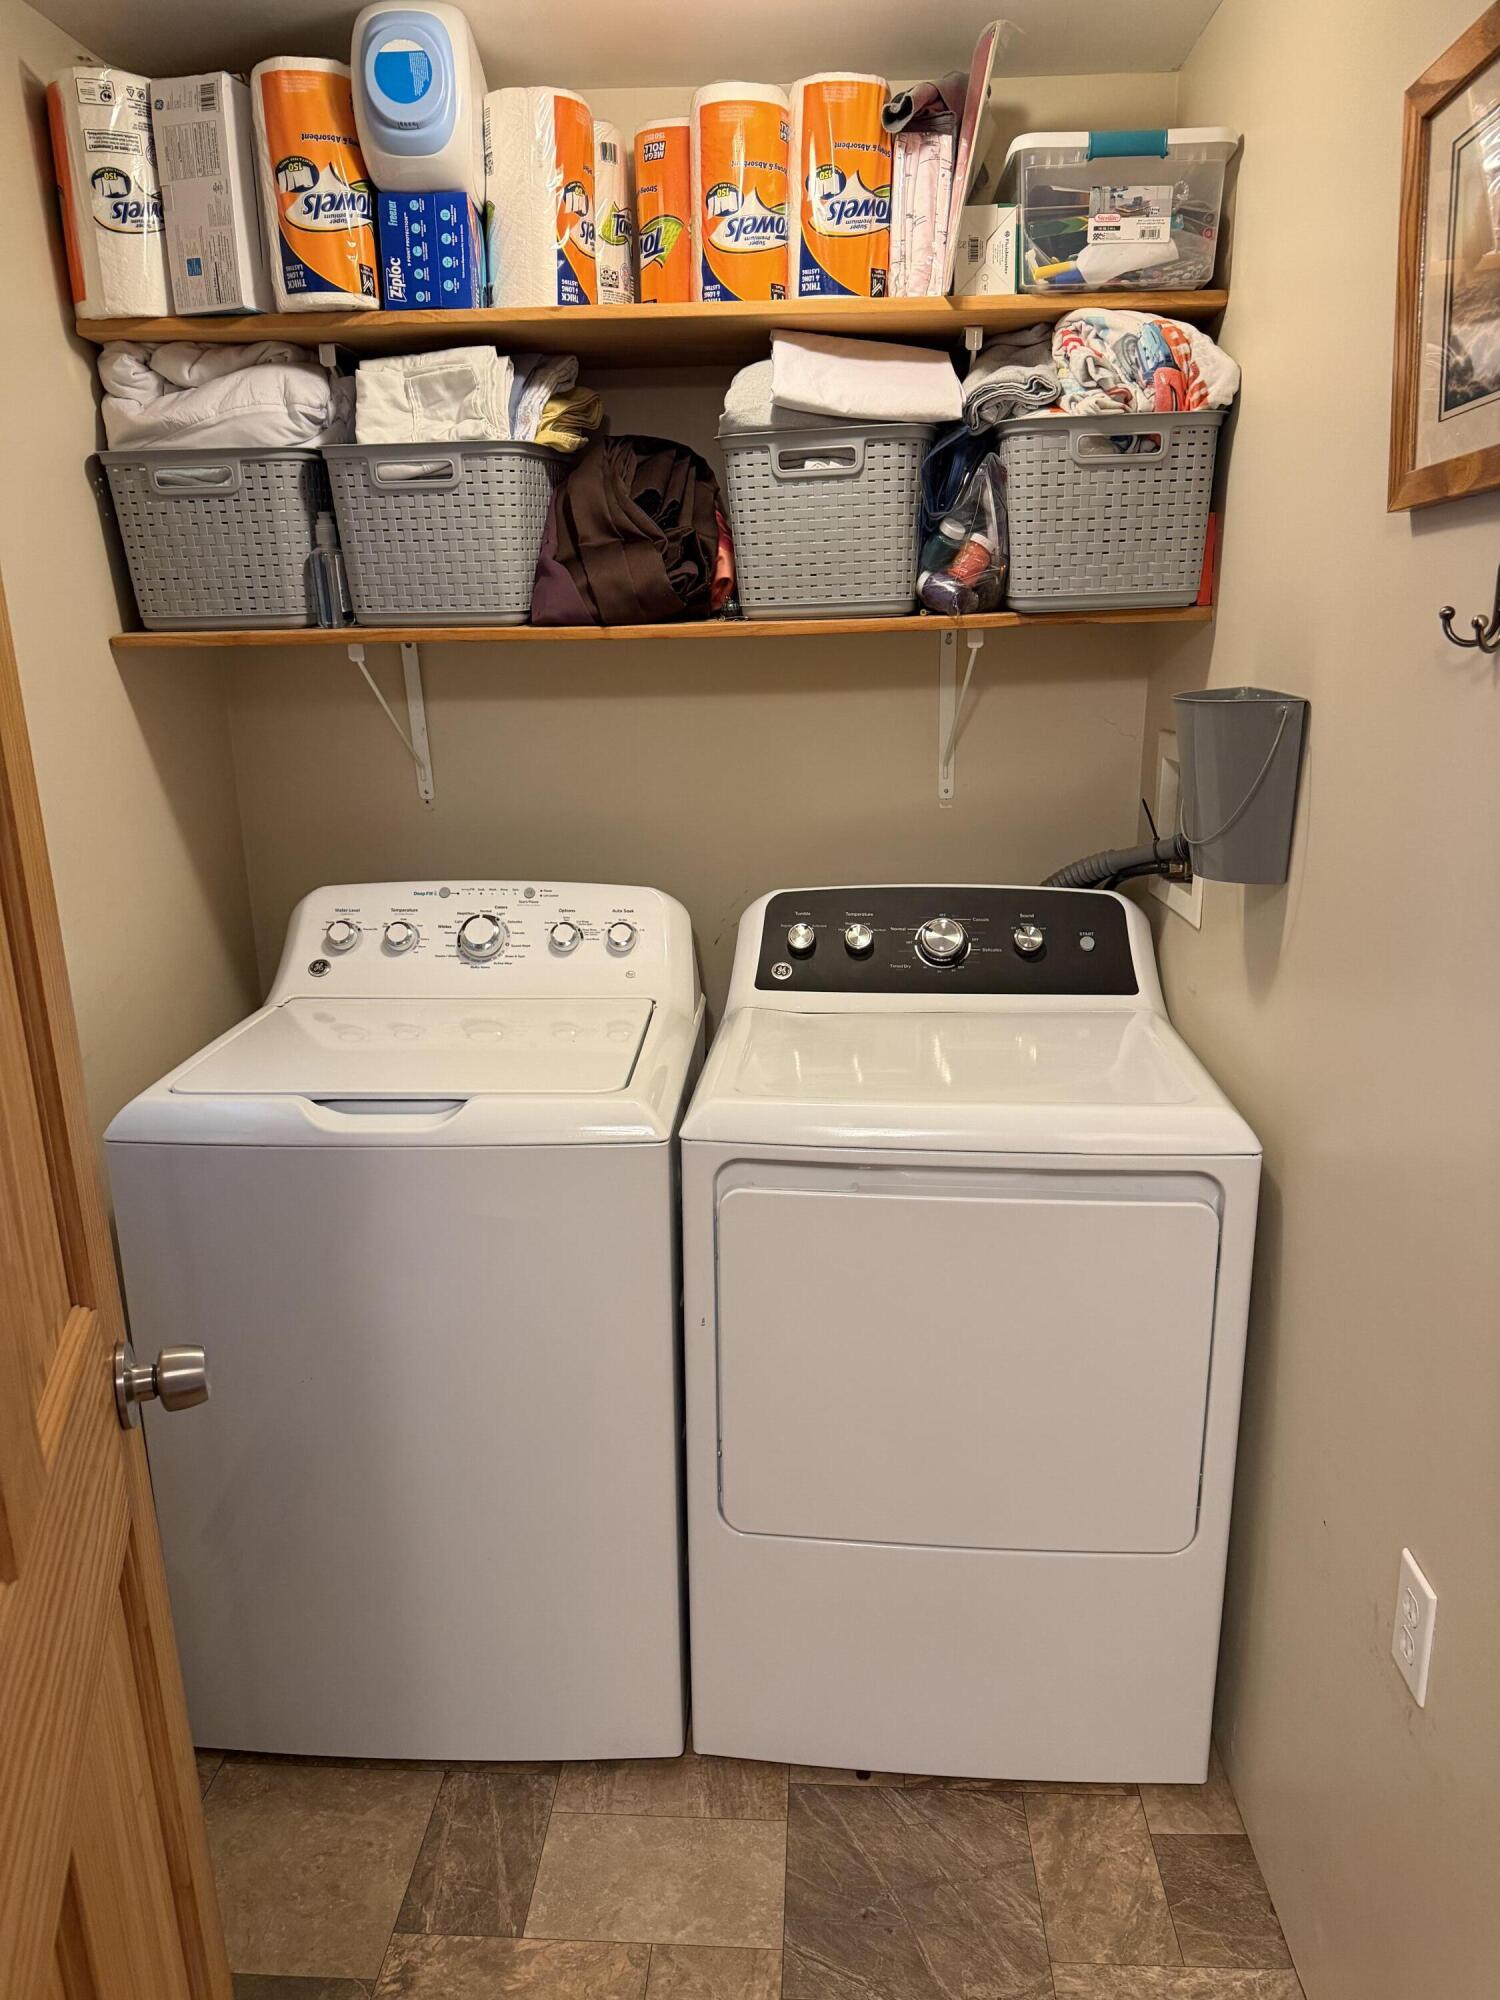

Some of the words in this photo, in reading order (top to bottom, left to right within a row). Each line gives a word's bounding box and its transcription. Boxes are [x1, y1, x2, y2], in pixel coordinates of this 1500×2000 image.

[301, 133, 342, 143] Absorbent
[644, 142, 665, 154] ROLL
[833, 142, 871, 151] Absorbent
[644, 151, 664, 161] MEGA
[288, 162, 302, 172] 150
[104, 172, 117, 180] 150
[819, 170, 832, 180] 150
[640, 185, 657, 194] Strong
[717, 187, 729, 197] 150
[388, 200, 398, 226] Freezer
[286, 264, 303, 272] LASTING
[389, 257, 406, 298] Ziploc
[287, 279, 307, 288] THICK
[704, 284, 720, 292] LASTING
[801, 281, 821, 291] THICK
[561, 285, 575, 293] LONG
[704, 290, 716, 298] LONG
[561, 293, 579, 303] THICK
